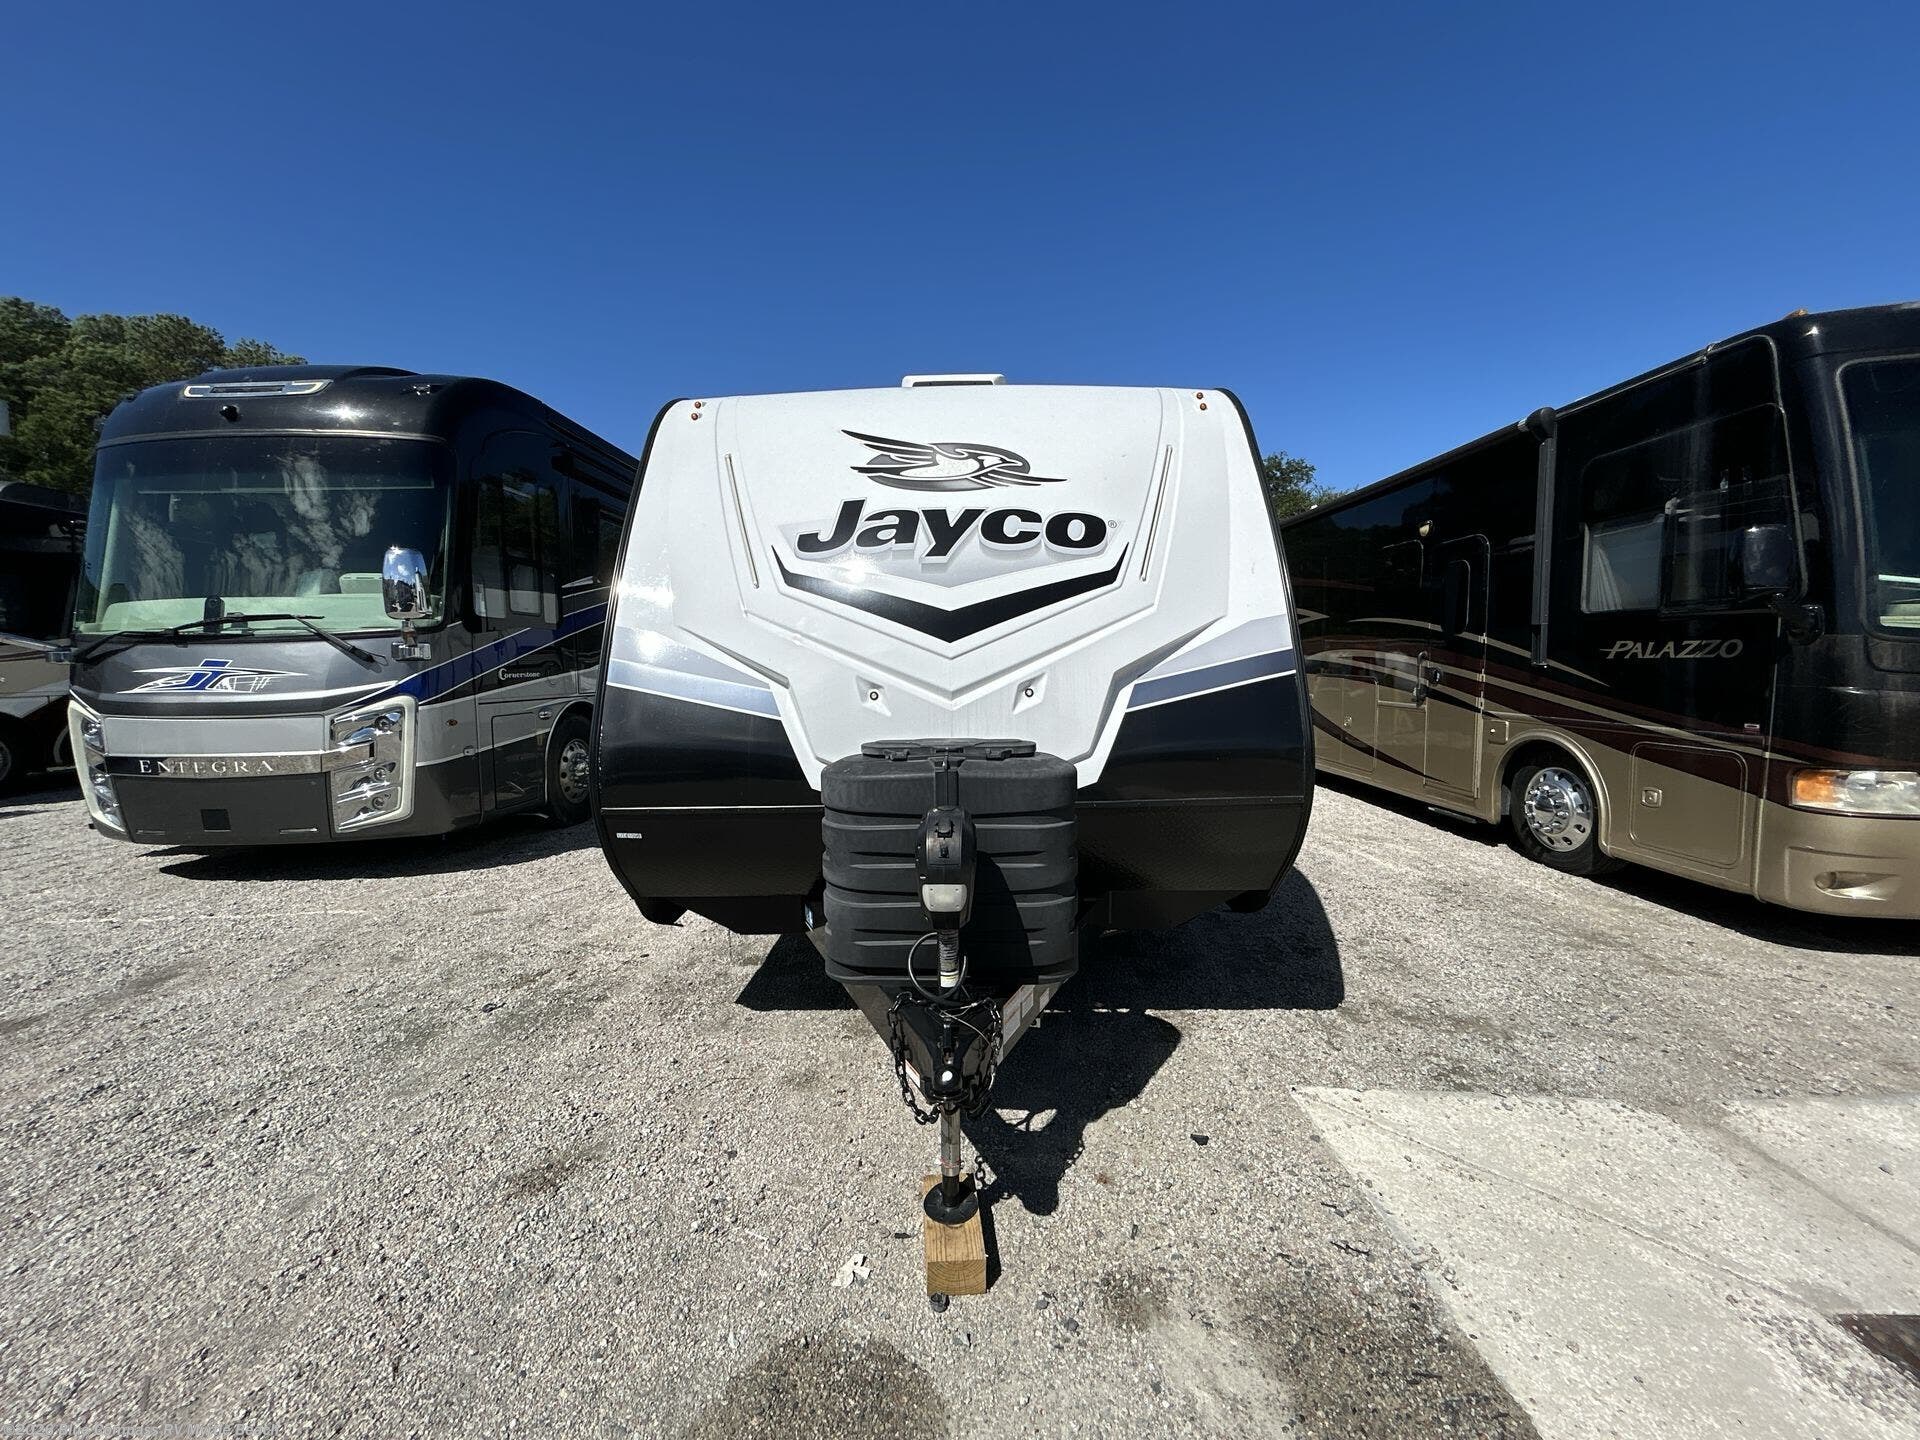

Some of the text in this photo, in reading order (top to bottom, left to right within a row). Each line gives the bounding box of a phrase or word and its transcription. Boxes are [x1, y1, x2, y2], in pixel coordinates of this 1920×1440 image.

[1600, 638, 1744, 659] PALAZZO
[498, 668, 541, 681] Cornerstone
[138, 759, 274, 775] ENTEGRA
